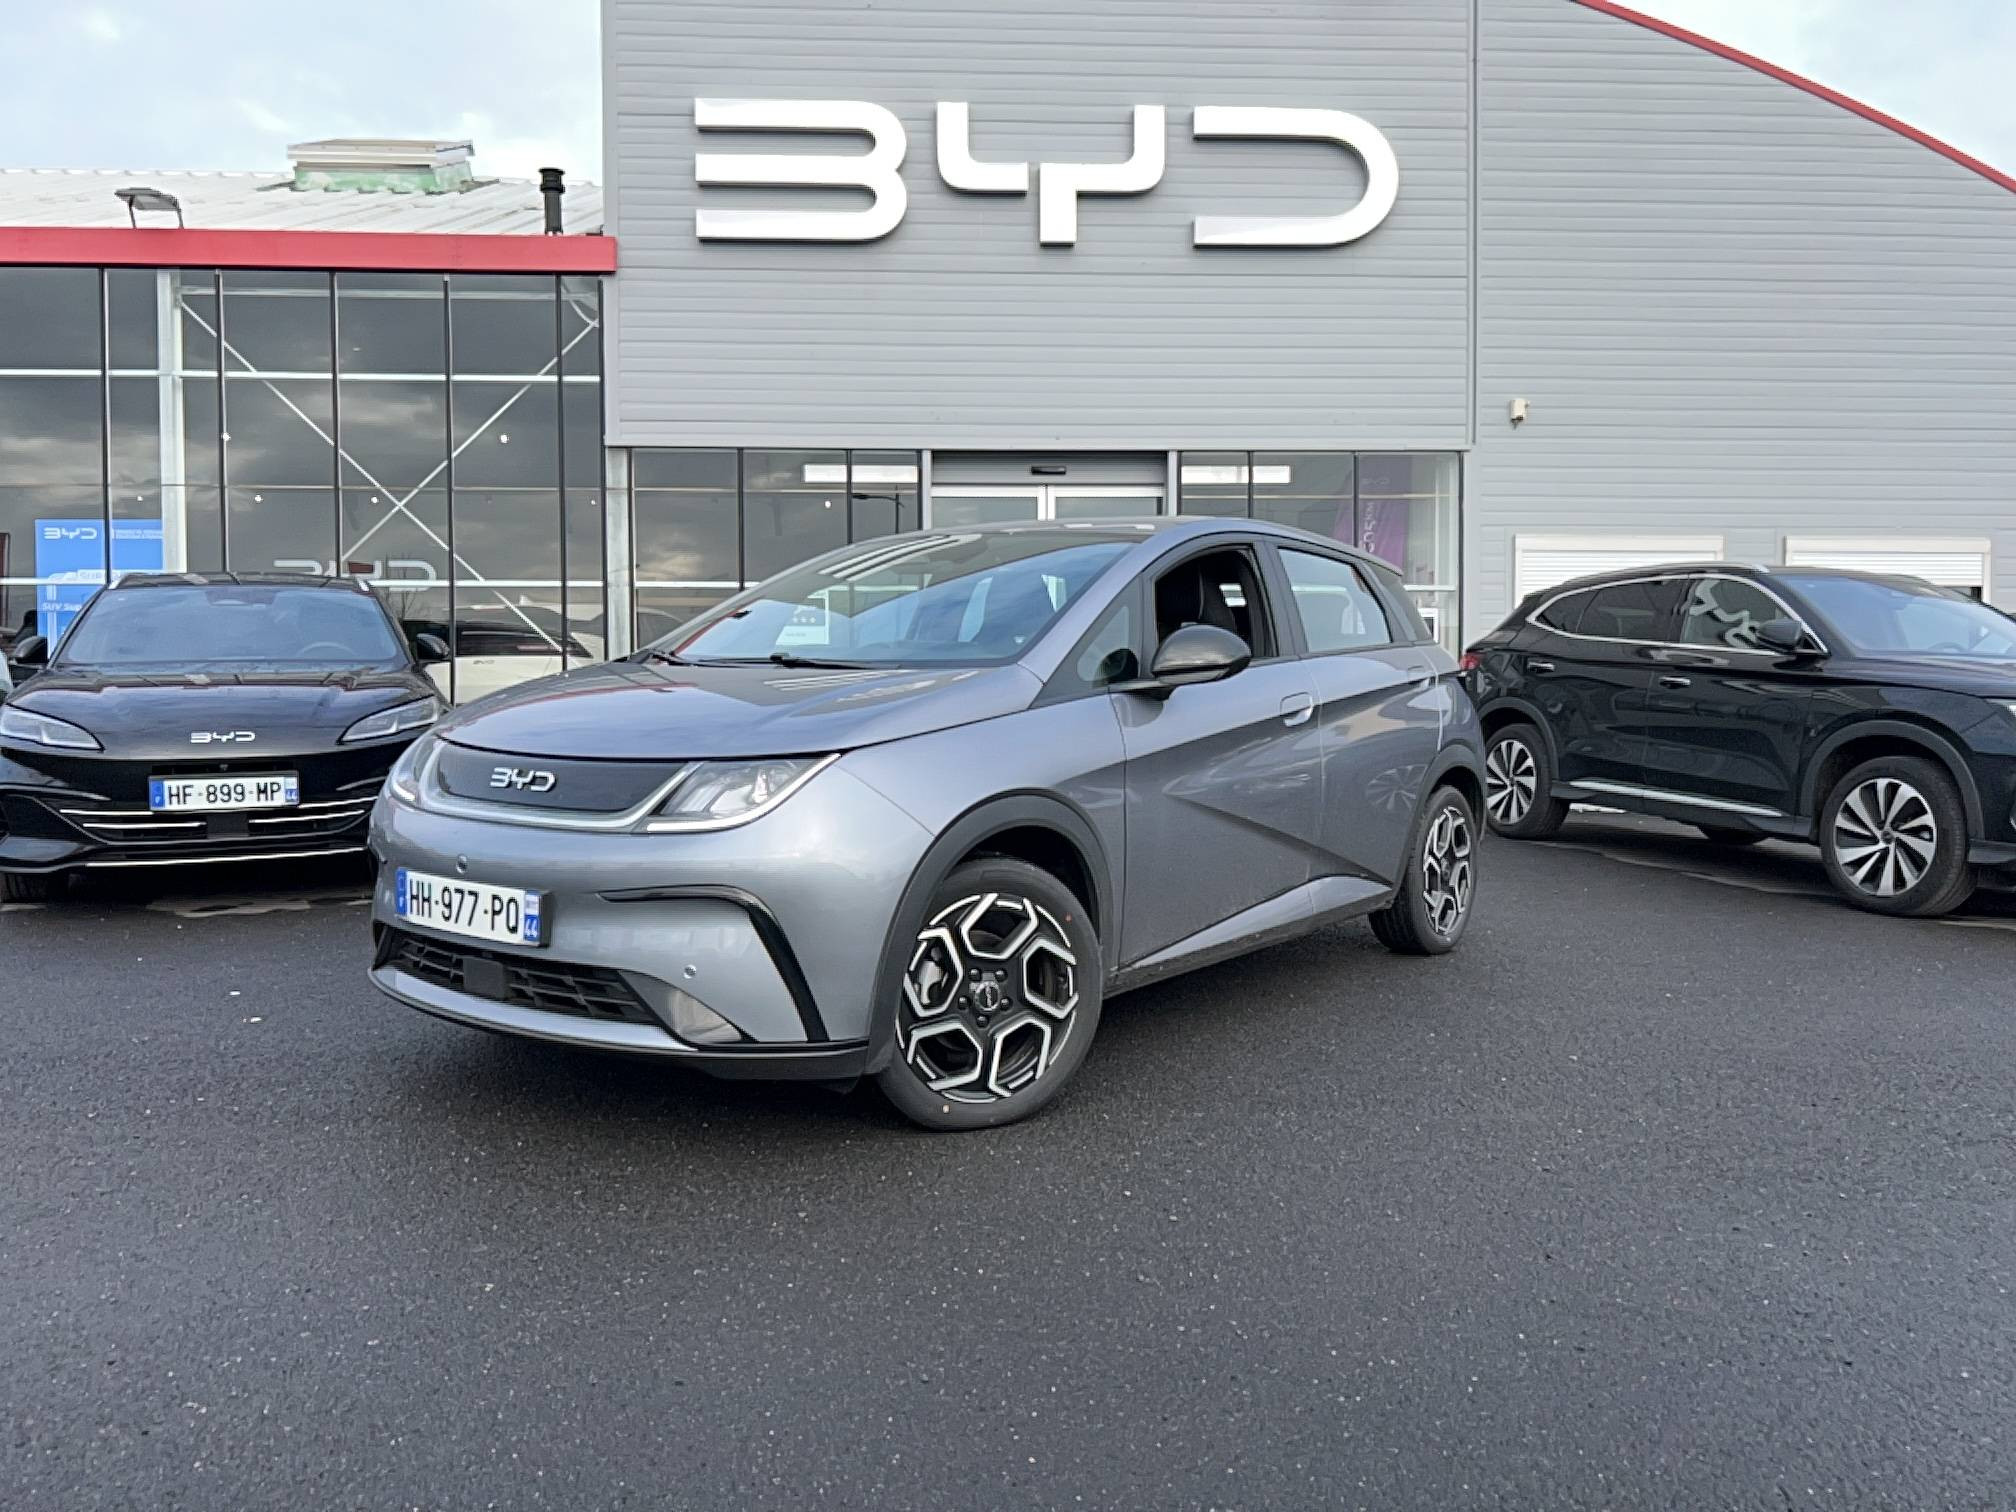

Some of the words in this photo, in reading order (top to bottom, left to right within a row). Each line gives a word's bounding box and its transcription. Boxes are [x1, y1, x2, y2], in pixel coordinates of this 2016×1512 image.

[694, 97, 1400, 249] BYD
[43, 527, 98, 540] BYD
[190, 731, 256, 744] BYD
[490, 766, 556, 792] BYD
